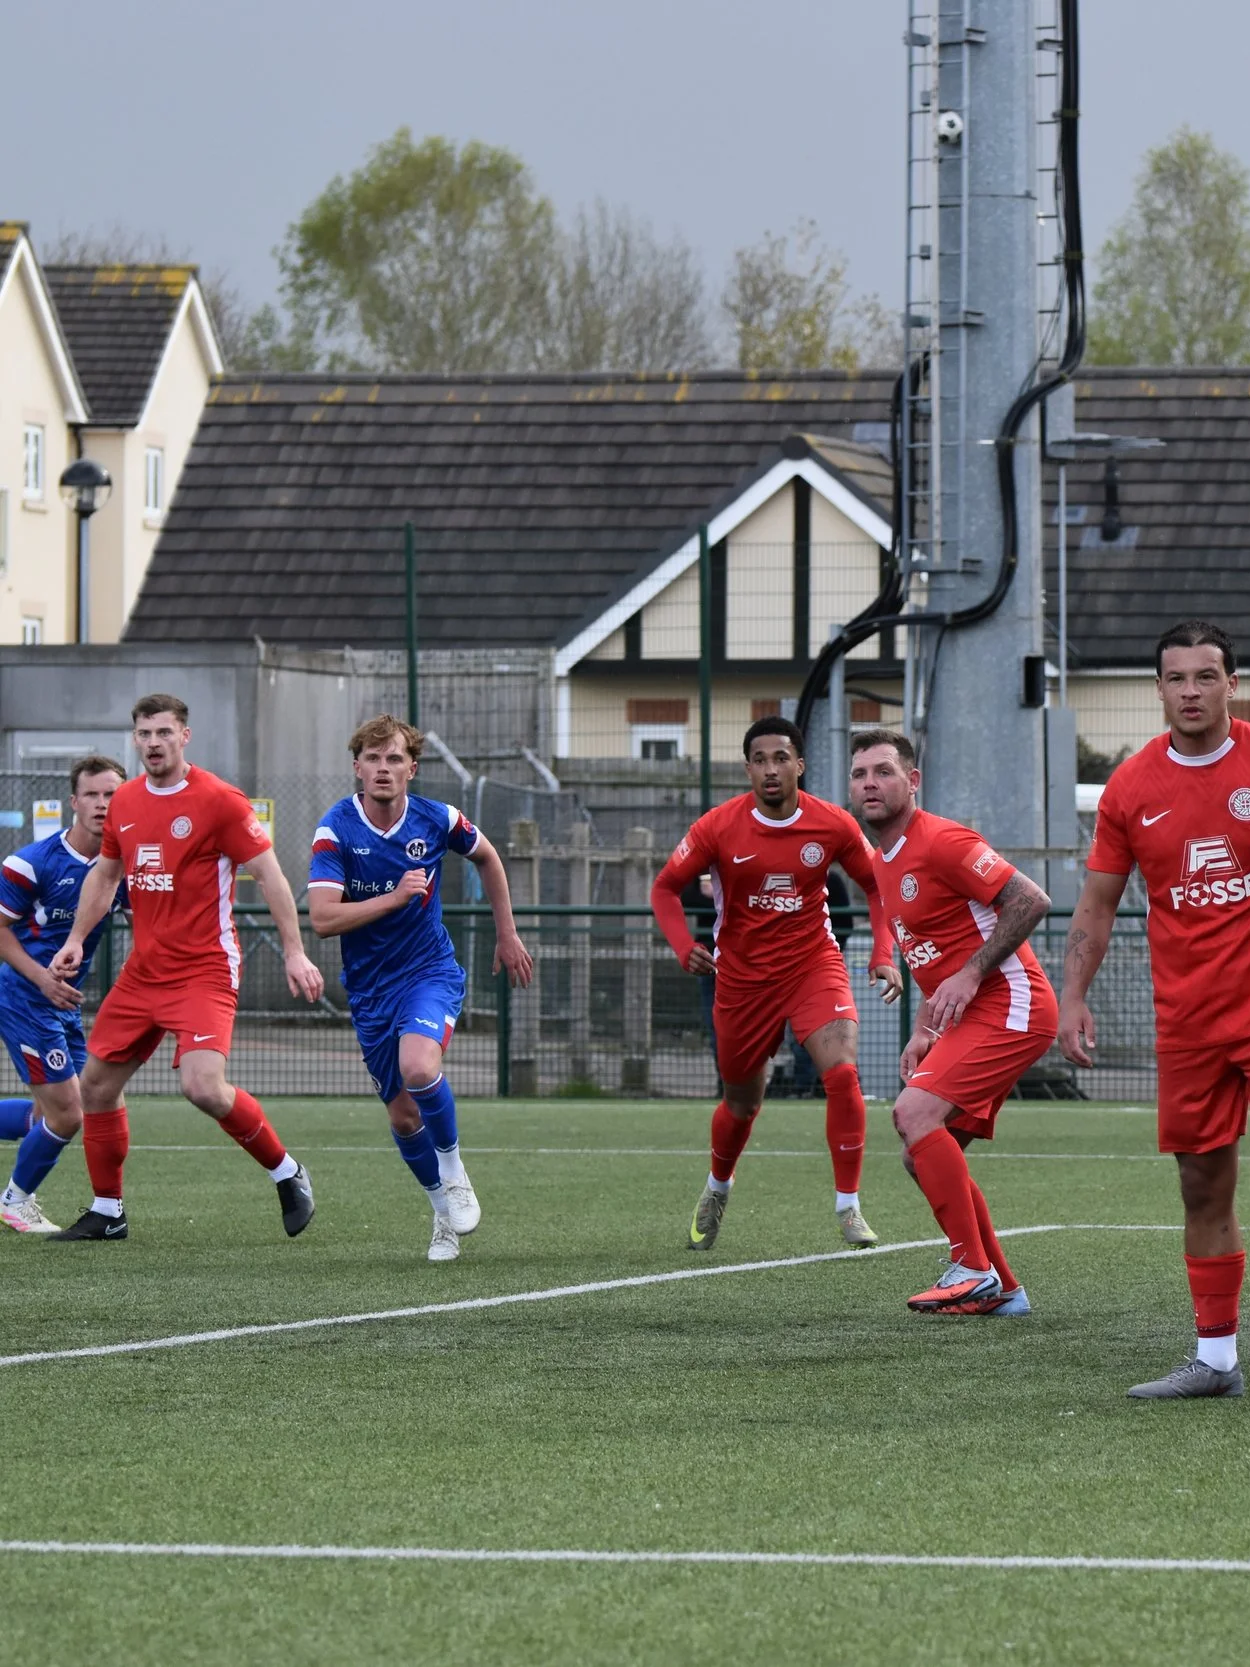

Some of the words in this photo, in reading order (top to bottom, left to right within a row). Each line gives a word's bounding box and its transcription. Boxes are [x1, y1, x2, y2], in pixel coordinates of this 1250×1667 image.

[128, 873, 174, 892] FOSSE
[351, 879, 380, 893] Flick
[385, 880, 396, 892] &
[748, 895, 803, 912] FOSSE
[52, 908, 76, 919] Flic
